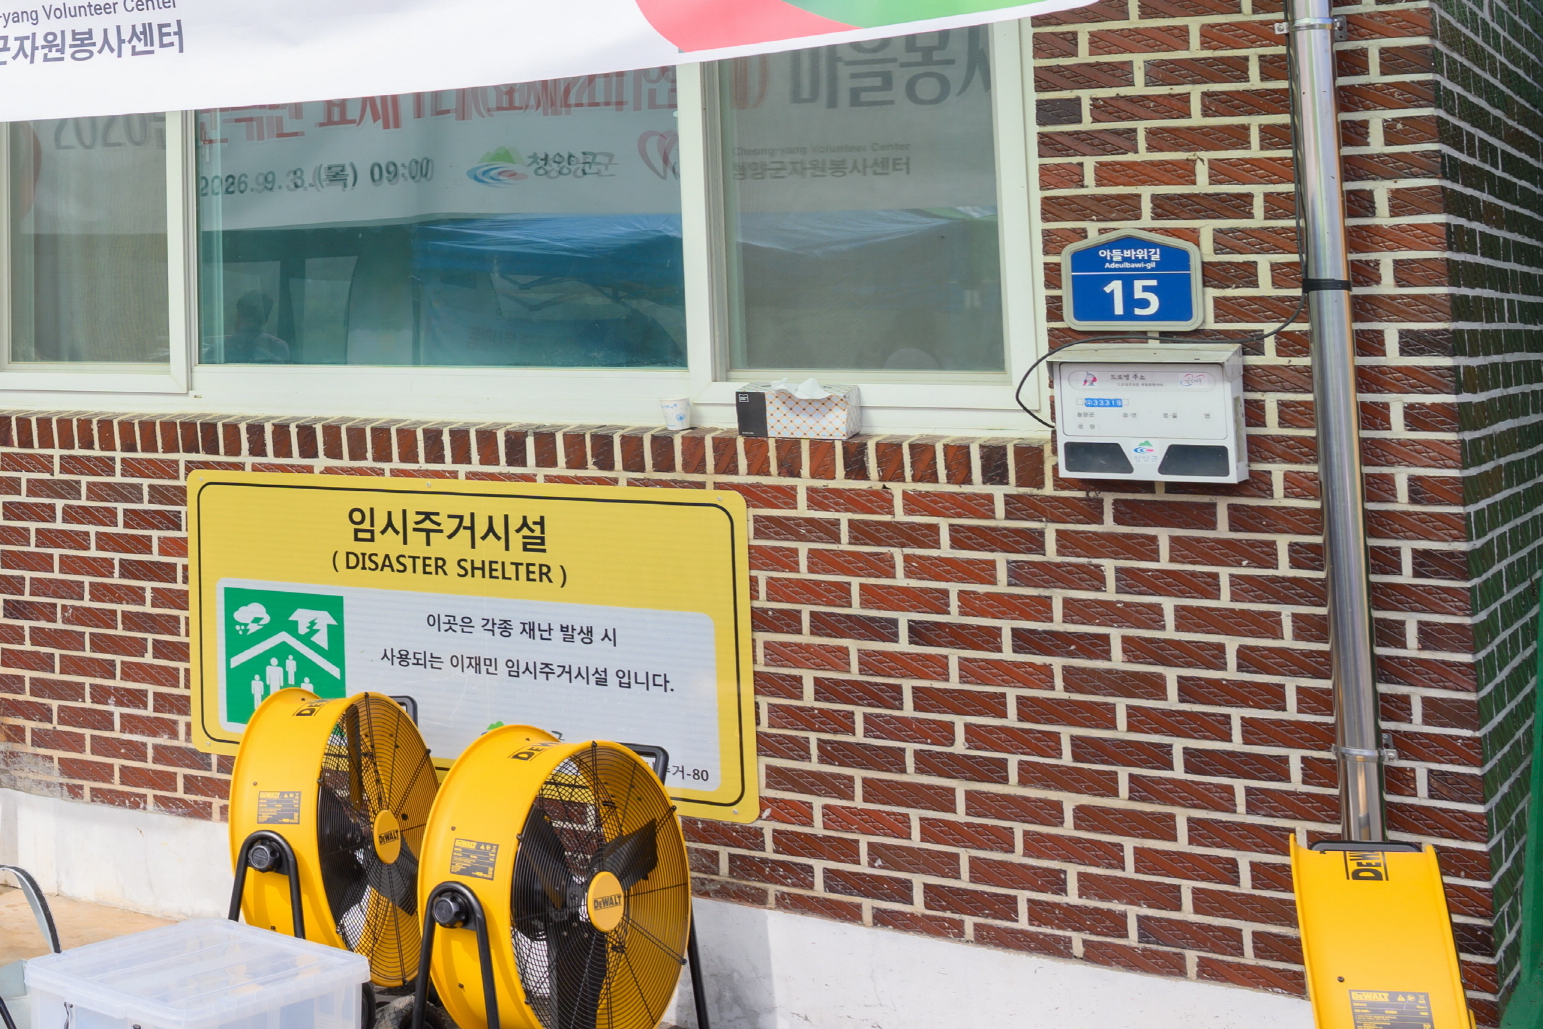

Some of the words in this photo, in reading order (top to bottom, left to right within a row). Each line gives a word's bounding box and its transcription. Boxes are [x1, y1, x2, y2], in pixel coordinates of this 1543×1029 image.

[42, 0, 120, 26] Volunteer
[1098, 248, 1161, 261] 아들바위길
[1103, 279, 1160, 316] 15
[1132, 373, 1146, 381] 주소
[347, 506, 548, 554] 임시주거시설
[425, 611, 476, 636] 이곳은
[480, 615, 514, 639] 각종
[519, 617, 555, 643] 재난
[559, 620, 594, 646] 발생
[600, 624, 618, 649] 시
[379, 645, 446, 673] 사용되는
[449, 650, 500, 677] 이재민
[504, 655, 610, 688] 임시주거시설
[614, 666, 676, 694] 입니다.
